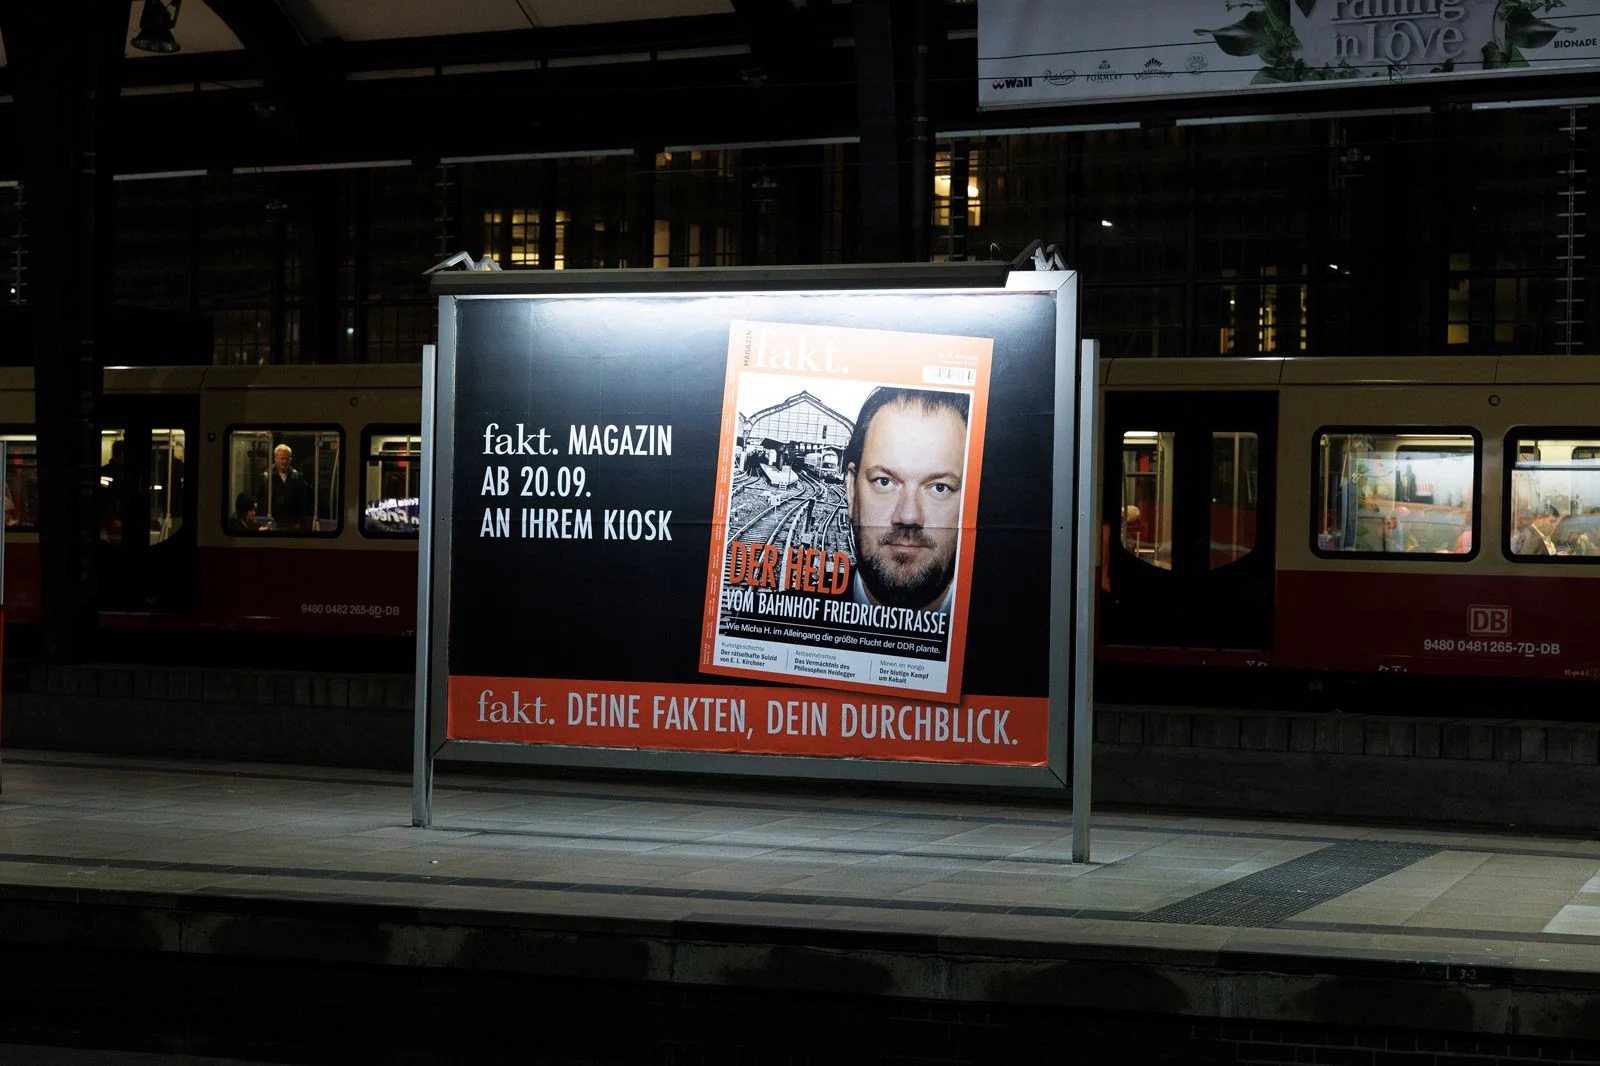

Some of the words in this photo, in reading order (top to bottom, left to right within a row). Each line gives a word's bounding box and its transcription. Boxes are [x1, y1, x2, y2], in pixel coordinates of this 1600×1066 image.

[1333, 32, 1360, 57] in
[1366, 20, 1464, 70] Love
[1554, 38, 1598, 49] BIONADE
[1006, 77, 1033, 88] Wall
[755, 329, 849, 375] fakt.
[482, 422, 559, 456] fakt.
[568, 424, 672, 456] MAGAZIN
[481, 466, 510, 496] AB
[520, 466, 592, 497] 20.09.
[480, 507, 511, 538] AN
[521, 508, 593, 540] IHREM
[604, 509, 673, 541] KIOSK
[729, 540, 778, 588] DER
[784, 546, 850, 595] HELD
[301, 603, 323, 614] 9480
[726, 588, 754, 613] VOM
[758, 592, 820, 620] BAHNHOF
[823, 599, 947, 635] FRIEDRICHSTRASSE
[1472, 609, 1507, 631] DB
[726, 622, 739, 631] Wie
[740, 623, 762, 634] Micha
[763, 626, 772, 634] H.
[773, 627, 782, 635] im
[783, 628, 820, 641] Alleingang
[821, 632, 833, 642] die
[834, 634, 858, 645] größte
[859, 637, 882, 647] Flucht
[883, 641, 896, 649] der
[897, 642, 915, 651] DDR
[915, 645, 941, 654] plante.
[1423, 639, 1455, 651] 9480
[827, 667, 856, 678] Heidegger
[839, 662, 850, 670] des
[879, 667, 889, 675] Der
[890, 668, 909, 678] blutige
[910, 671, 929, 680] Kampf
[476, 689, 555, 726] fakt.
[567, 692, 641, 729] DEINE
[652, 695, 754, 740] FAKTEN,
[767, 700, 827, 737] DEIN
[841, 703, 1019, 746] DURCHBLICK.
